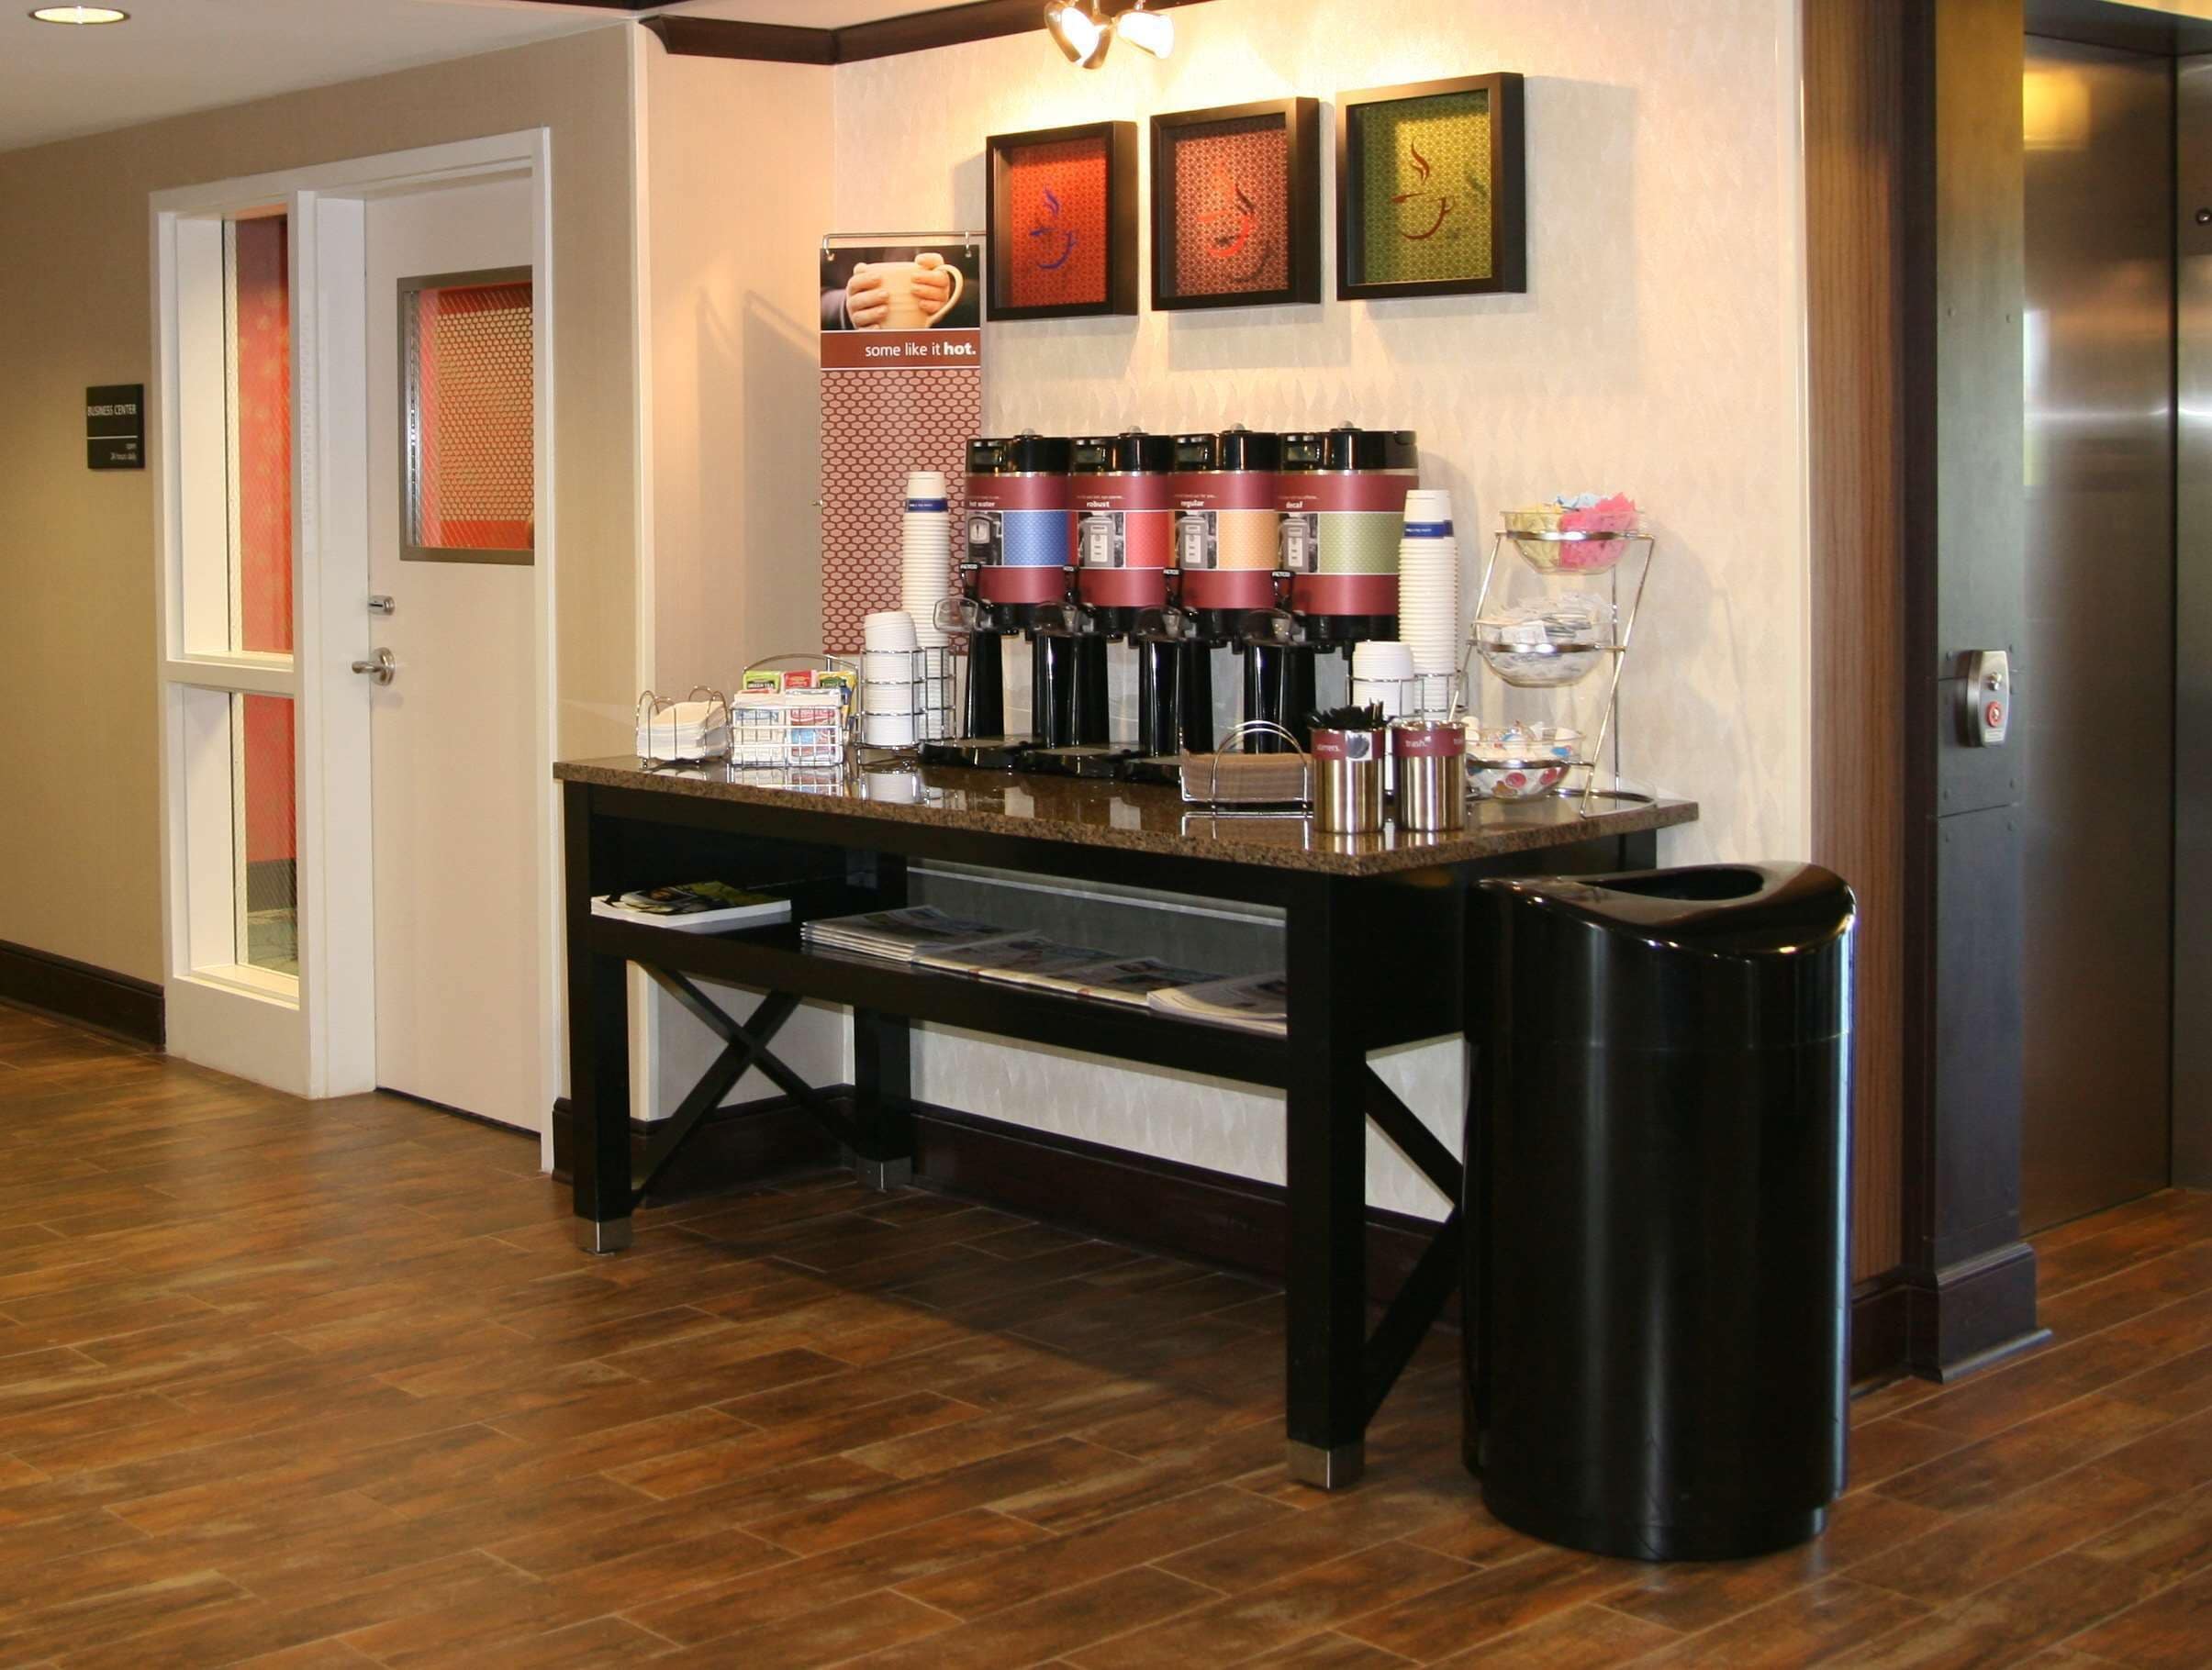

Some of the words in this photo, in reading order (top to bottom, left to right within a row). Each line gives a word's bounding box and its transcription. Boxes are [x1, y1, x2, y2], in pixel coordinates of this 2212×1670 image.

[866, 344, 900, 357] some
[905, 342, 928, 356] like
[932, 342, 941, 356] it
[944, 341, 976, 356] hot.
[87, 405, 113, 417] BUSINESS
[114, 404, 137, 416] CENTER
[1086, 500, 1110, 508] robust
[1180, 499, 1204, 508] regular
[1286, 500, 1303, 508] decaf
